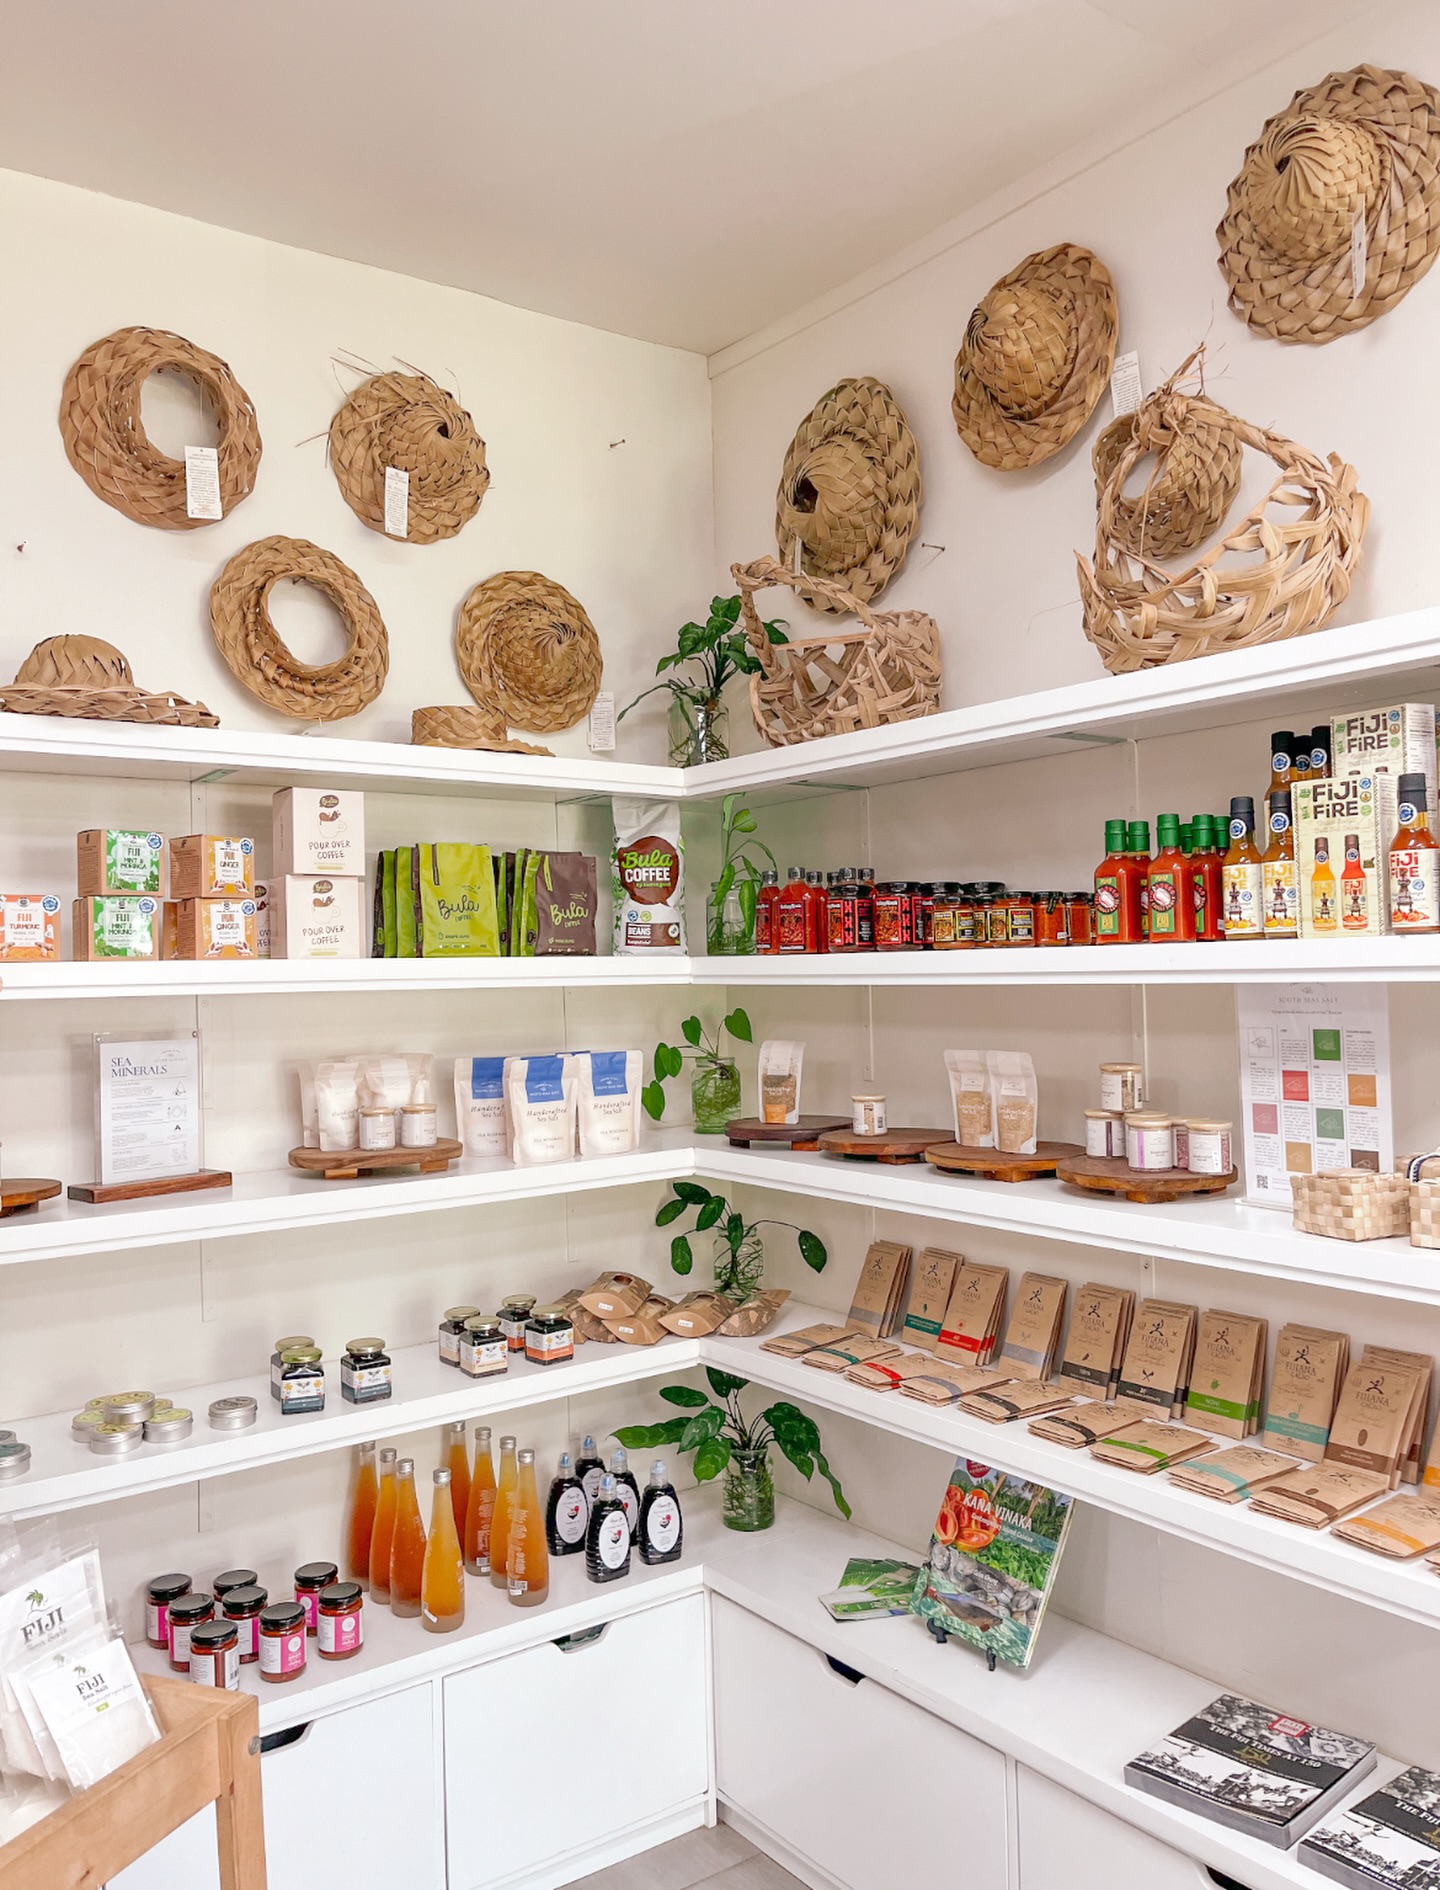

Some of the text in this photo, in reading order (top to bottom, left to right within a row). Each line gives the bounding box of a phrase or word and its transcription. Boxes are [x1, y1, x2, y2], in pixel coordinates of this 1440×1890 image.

[308, 840, 351, 850] POUR OVER
[127, 848, 140, 857] FIJI
[317, 851, 345, 860] COFFEE
[620, 849, 673, 868] Bula
[625, 868, 670, 882] COFFEE
[438, 894, 479, 920] Bula
[17, 913, 32, 922] FIJI
[116, 914, 130, 922] FIJI
[550, 902, 588, 926] Bula
[302, 925, 345, 937] POUR OVER
[627, 927, 651, 936] BEANS
[311, 936, 340, 946] COFFEE
[111, 1058, 132, 1068] SEA
[111, 1065, 168, 1078] MINERALS
[593, 1101, 630, 1109] Handcrafted
[527, 1108, 567, 1116] Handcrafted
[1285, 1362, 1316, 1376] FIJIANA
[1356, 1392, 1389, 1406] FIJIANA
[963, 1493, 1032, 1531] KANA VINAKA
[20, 1606, 65, 1644] FIJI
[75, 1673, 105, 1695] FIJI
[1209, 1724, 1322, 1768] THE FIJI TIMES AT 150
[1395, 1800, 1420, 1816] THE
